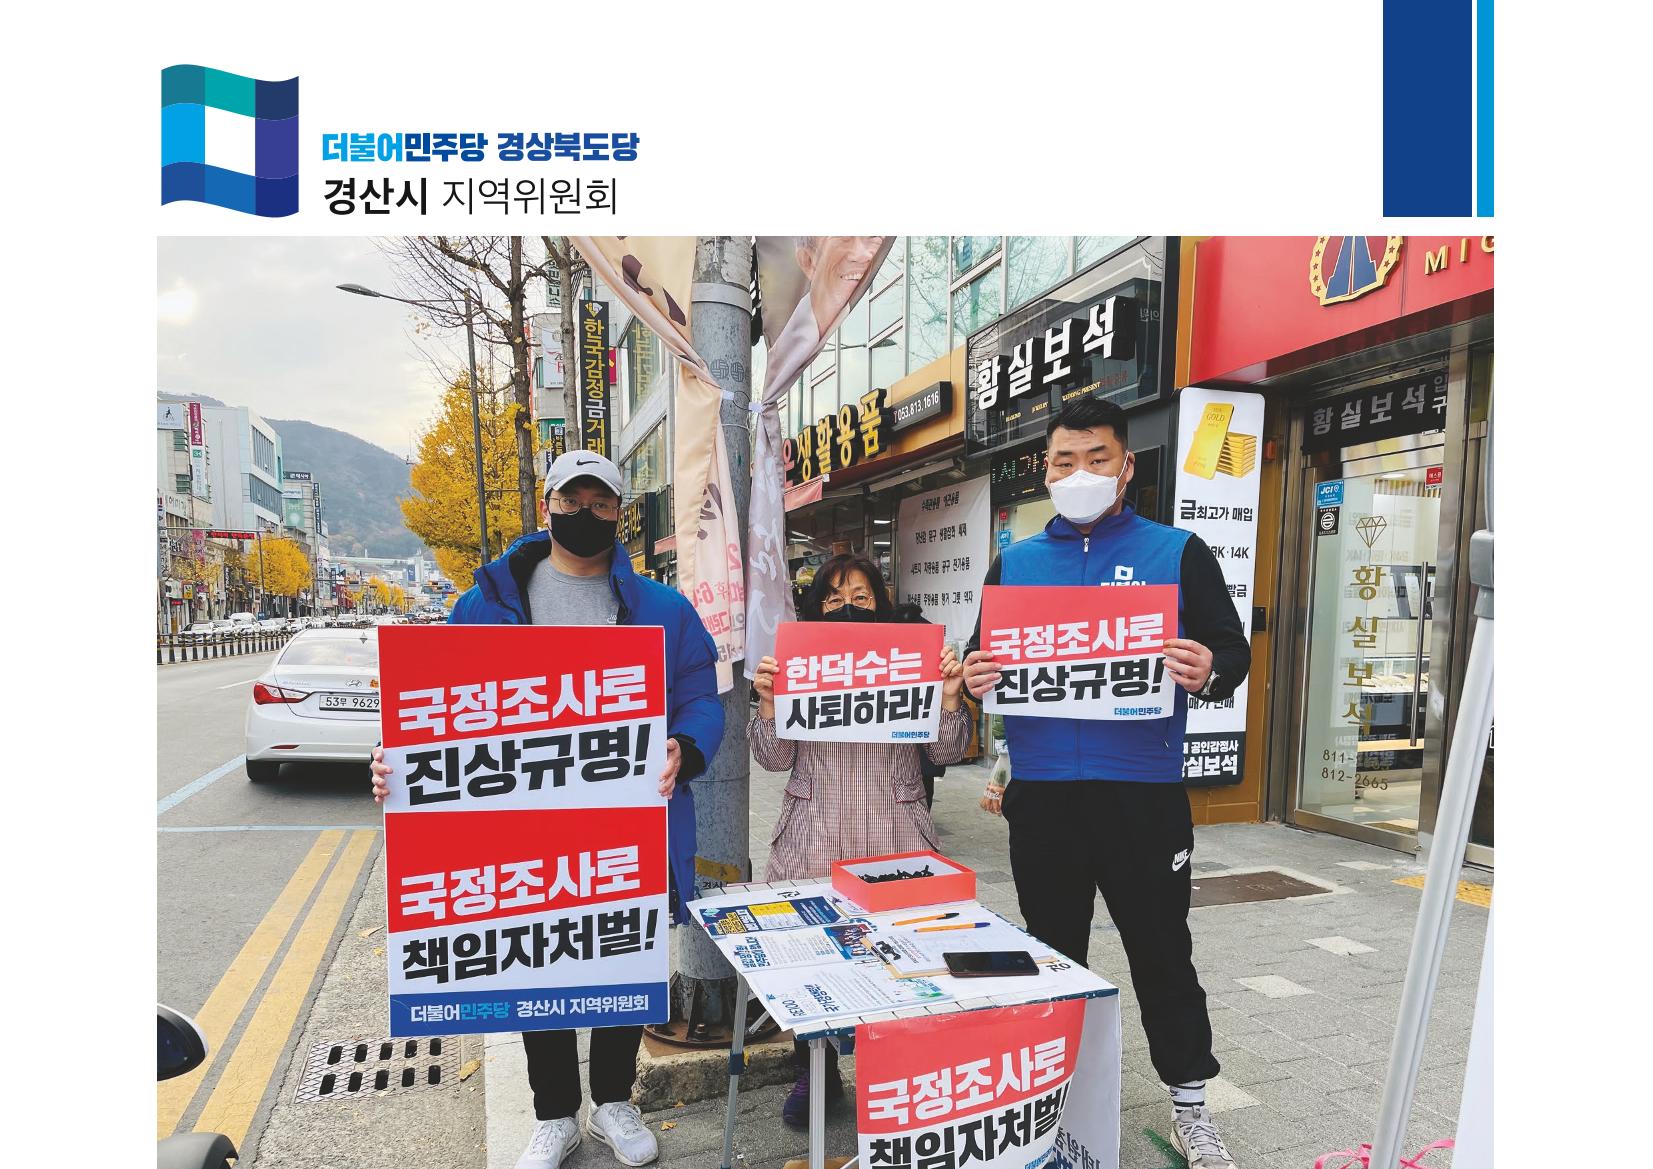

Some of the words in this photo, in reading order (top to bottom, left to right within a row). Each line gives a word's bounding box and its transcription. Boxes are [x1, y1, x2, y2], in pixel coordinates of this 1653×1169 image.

[978, 295, 1117, 411] 황실보석
[797, 387, 883, 482] 생활용품
[1312, 383, 1427, 436] 황실보석
[1180, 499, 1230, 521] 금최고가
[1232, 507, 1253, 521] 매입
[989, 612, 1165, 662] 국정조사로
[1342, 566, 1386, 736] 황실보석
[785, 646, 922, 692] 한덕수는
[995, 656, 1166, 706] 진상규명!
[352, 698, 380, 709] 9629
[398, 664, 648, 737] 국정조사로
[785, 685, 935, 731] 사퇴하라!
[1113, 706, 1162, 717] 더불어민주당
[405, 723, 652, 806] 진상규명!
[1190, 740, 1239, 754] 공인감정사
[1321, 766, 1389, 791] 812-2665
[399, 844, 641, 921] 국정조사로
[402, 907, 659, 985] 책임자처벌!
[410, 1001, 511, 1023] 더불어민주당
[516, 996, 566, 1018] 경산시
[569, 993, 649, 1015] 지역위원회
[867, 1036, 1067, 1126] 국정조사로
